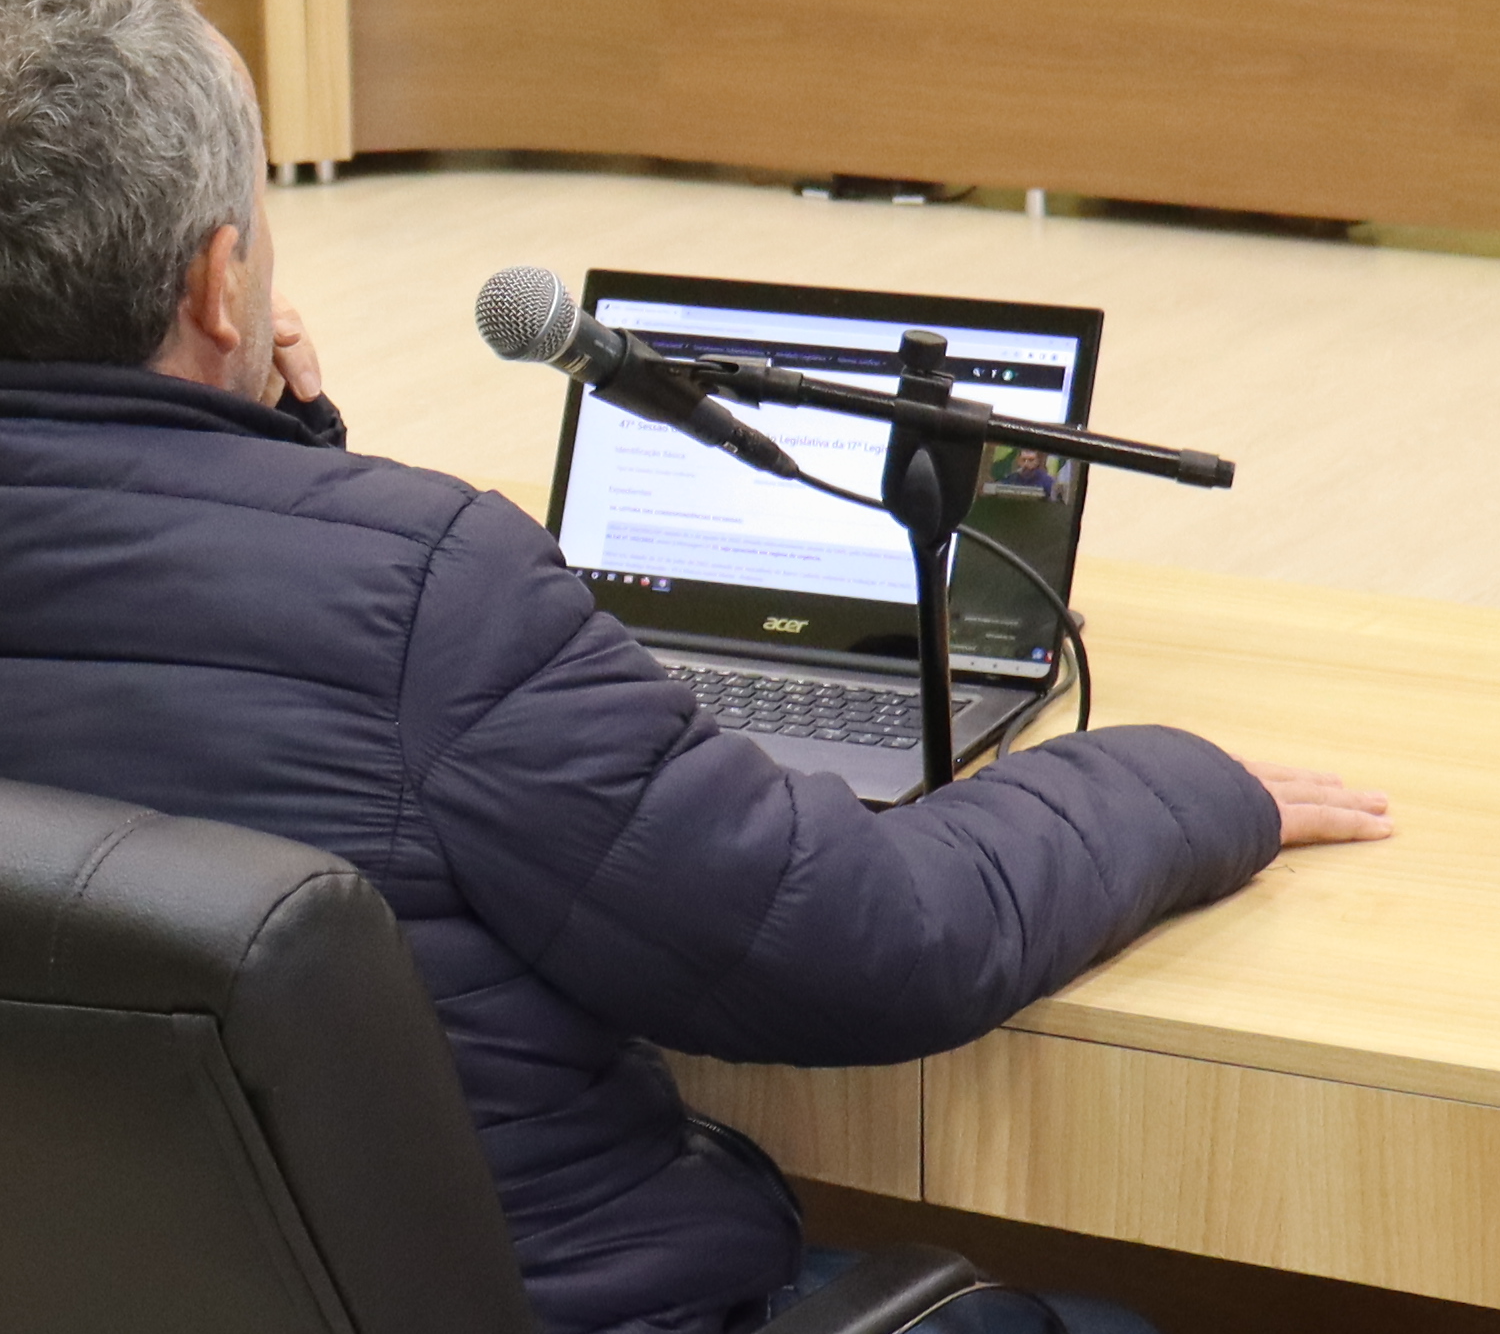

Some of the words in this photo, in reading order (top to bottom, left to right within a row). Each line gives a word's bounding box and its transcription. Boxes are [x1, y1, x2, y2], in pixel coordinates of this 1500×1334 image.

[780, 435, 829, 448] Legislativa
[832, 440, 844, 449] da
[762, 617, 809, 634] acer
